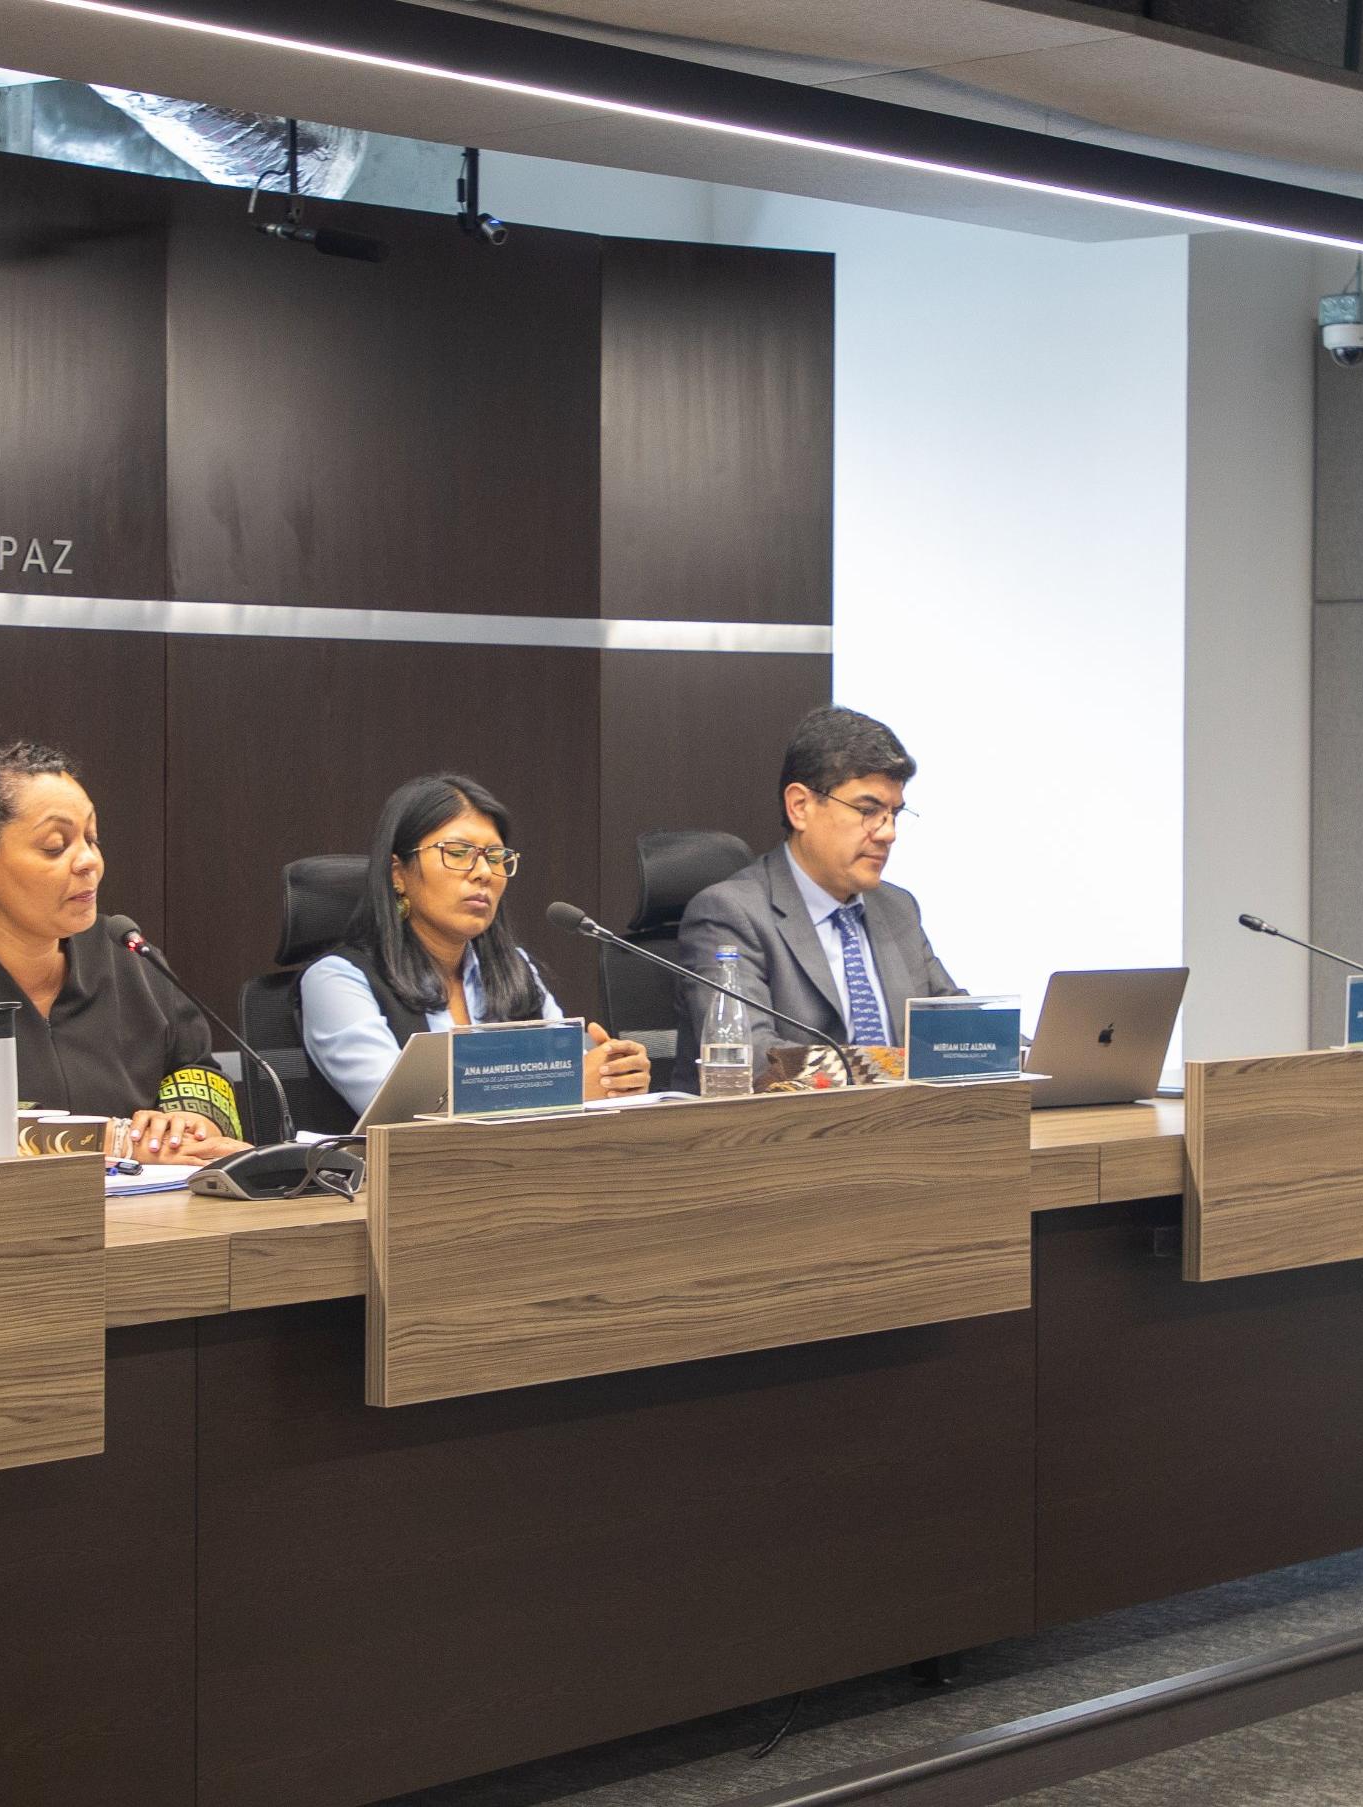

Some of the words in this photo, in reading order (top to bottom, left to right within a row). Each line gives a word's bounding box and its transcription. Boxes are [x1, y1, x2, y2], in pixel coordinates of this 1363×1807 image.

[970, 1043, 996, 1051] ALDANA
[464, 1067, 481, 1076] ANA
[482, 1064, 519, 1075] MANUELA
[521, 1062, 549, 1072] OCHOA
[550, 1060, 572, 1070] ARIAS
